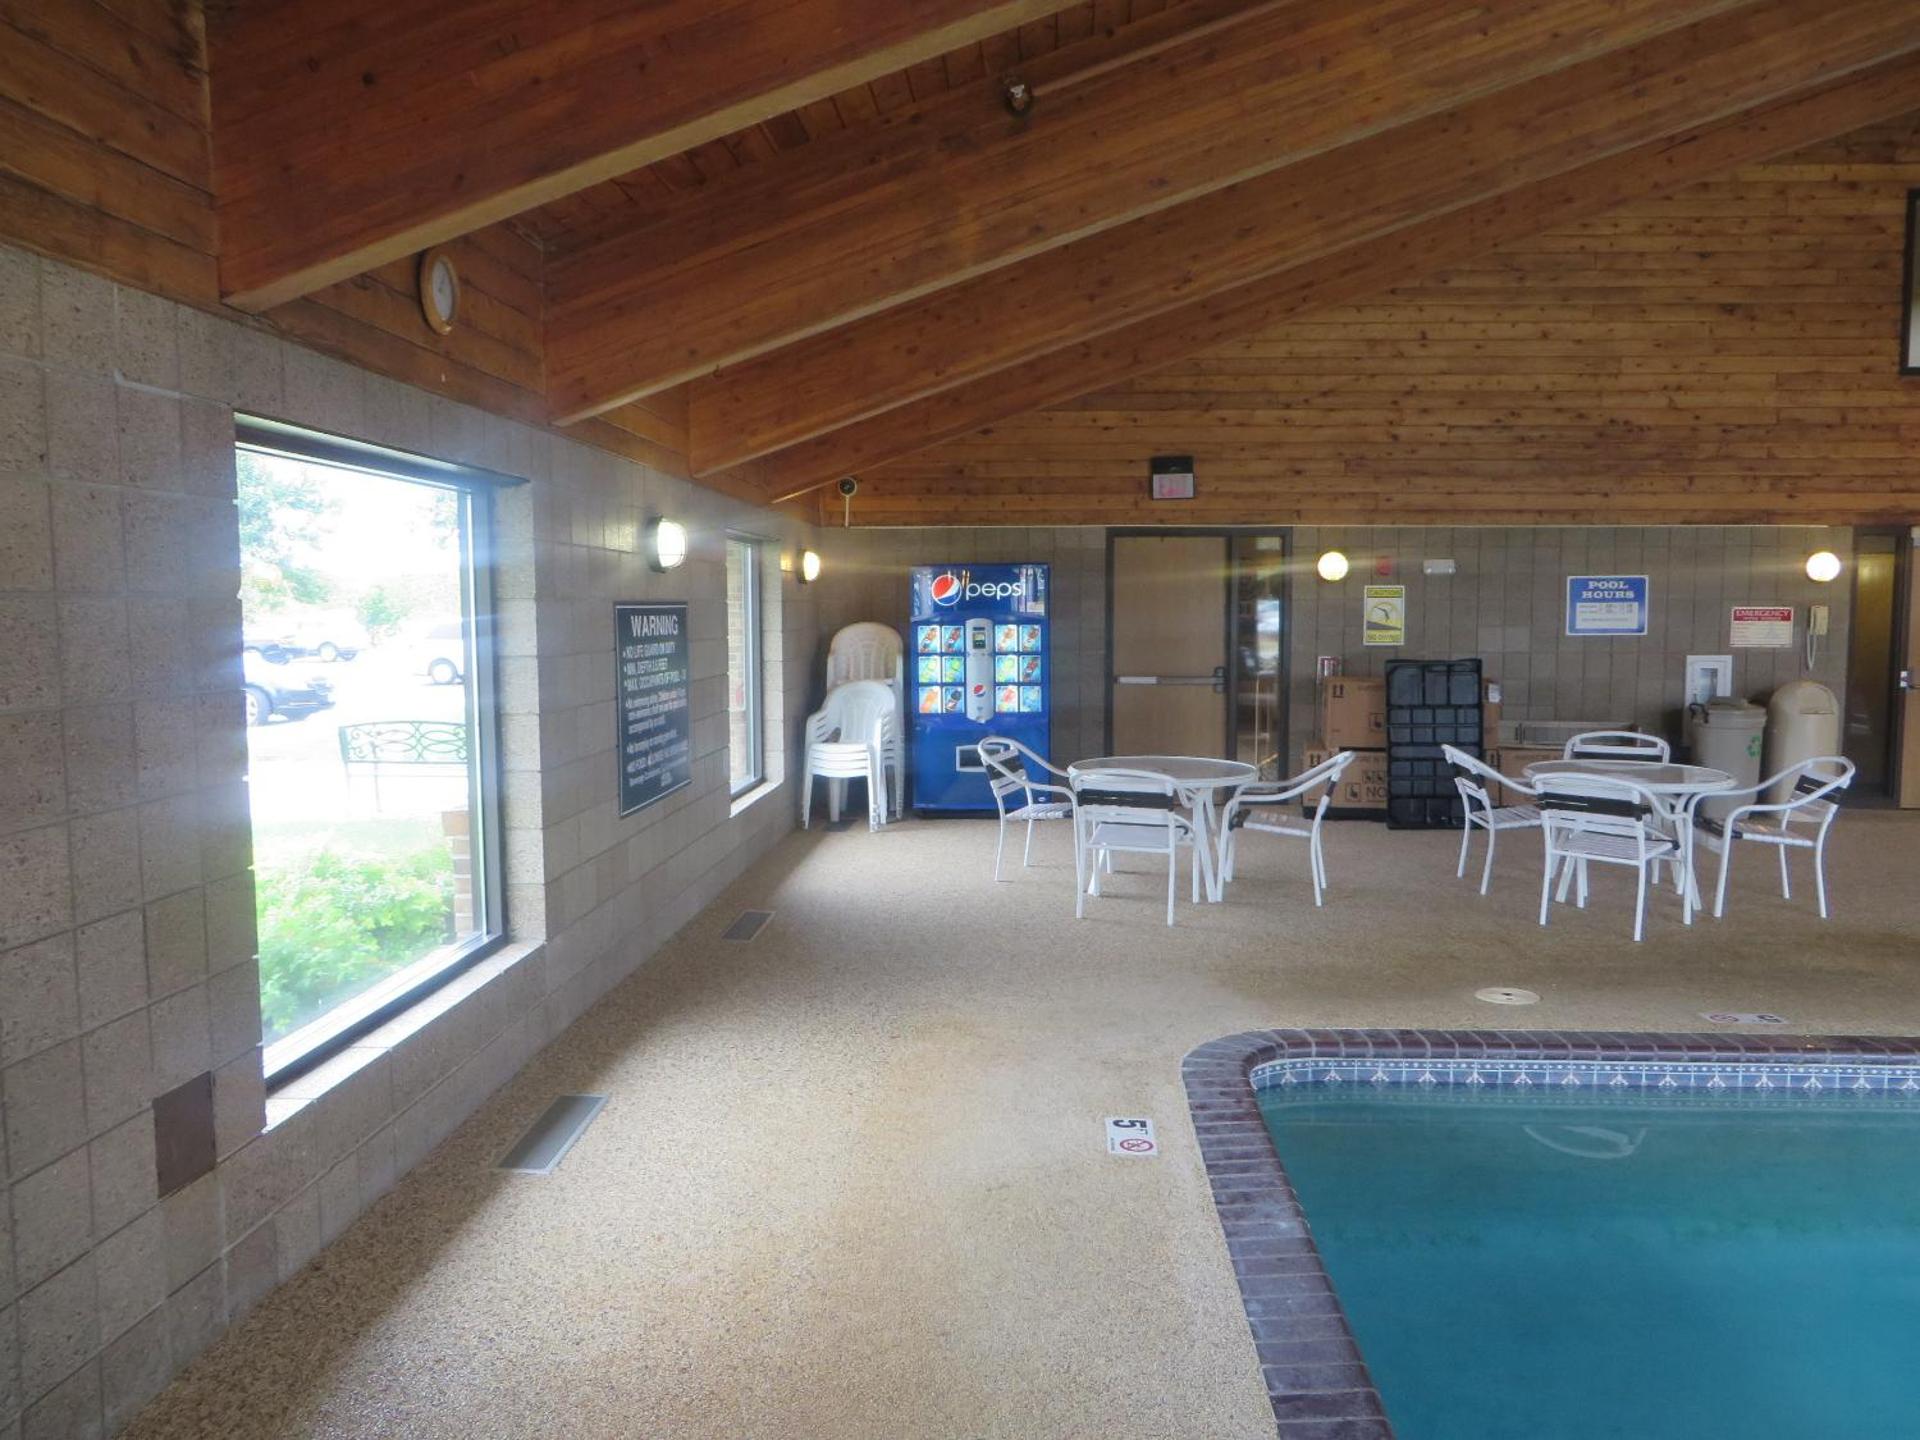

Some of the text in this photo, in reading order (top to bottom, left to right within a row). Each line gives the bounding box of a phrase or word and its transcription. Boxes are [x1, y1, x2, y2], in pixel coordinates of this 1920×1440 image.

[1588, 581, 1629, 589] POOL
[966, 582, 1026, 600] pepsi
[1582, 591, 1634, 599] HOURS
[631, 615, 678, 637] WARNING
[1113, 1120, 1147, 1128] 5
